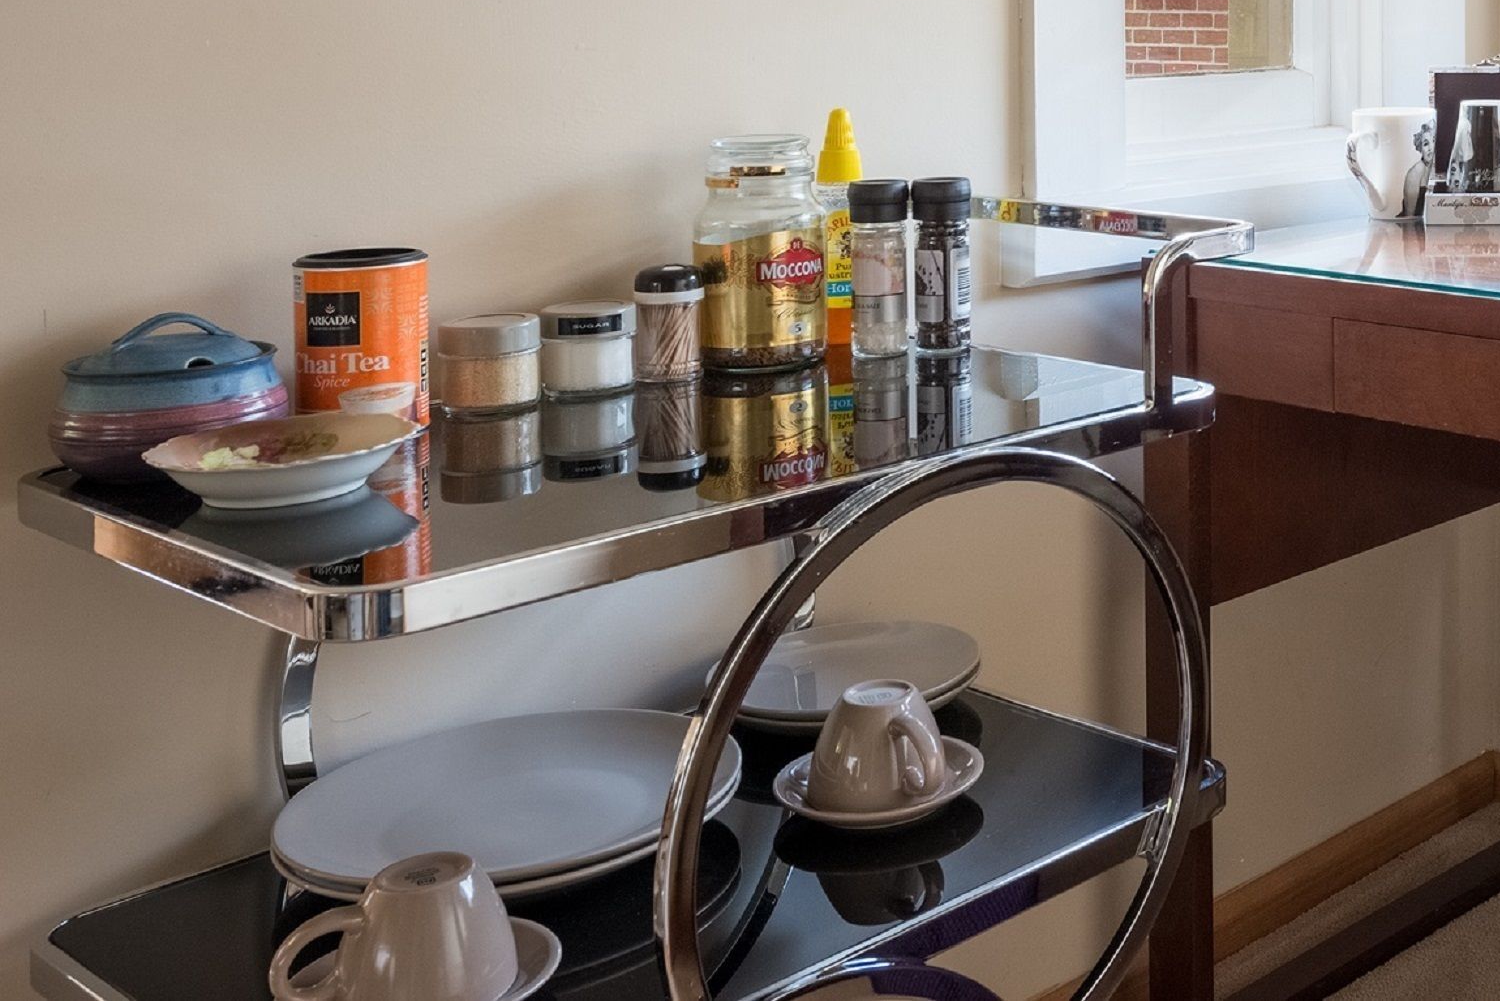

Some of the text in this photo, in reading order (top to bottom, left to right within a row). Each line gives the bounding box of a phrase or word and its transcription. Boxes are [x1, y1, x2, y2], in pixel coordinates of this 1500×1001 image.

[760, 258, 822, 280] MOCCONA
[309, 315, 356, 326] ARKADIA
[795, 323, 802, 332] 5
[296, 352, 390, 374] Chai Tea
[314, 375, 350, 390] Spice
